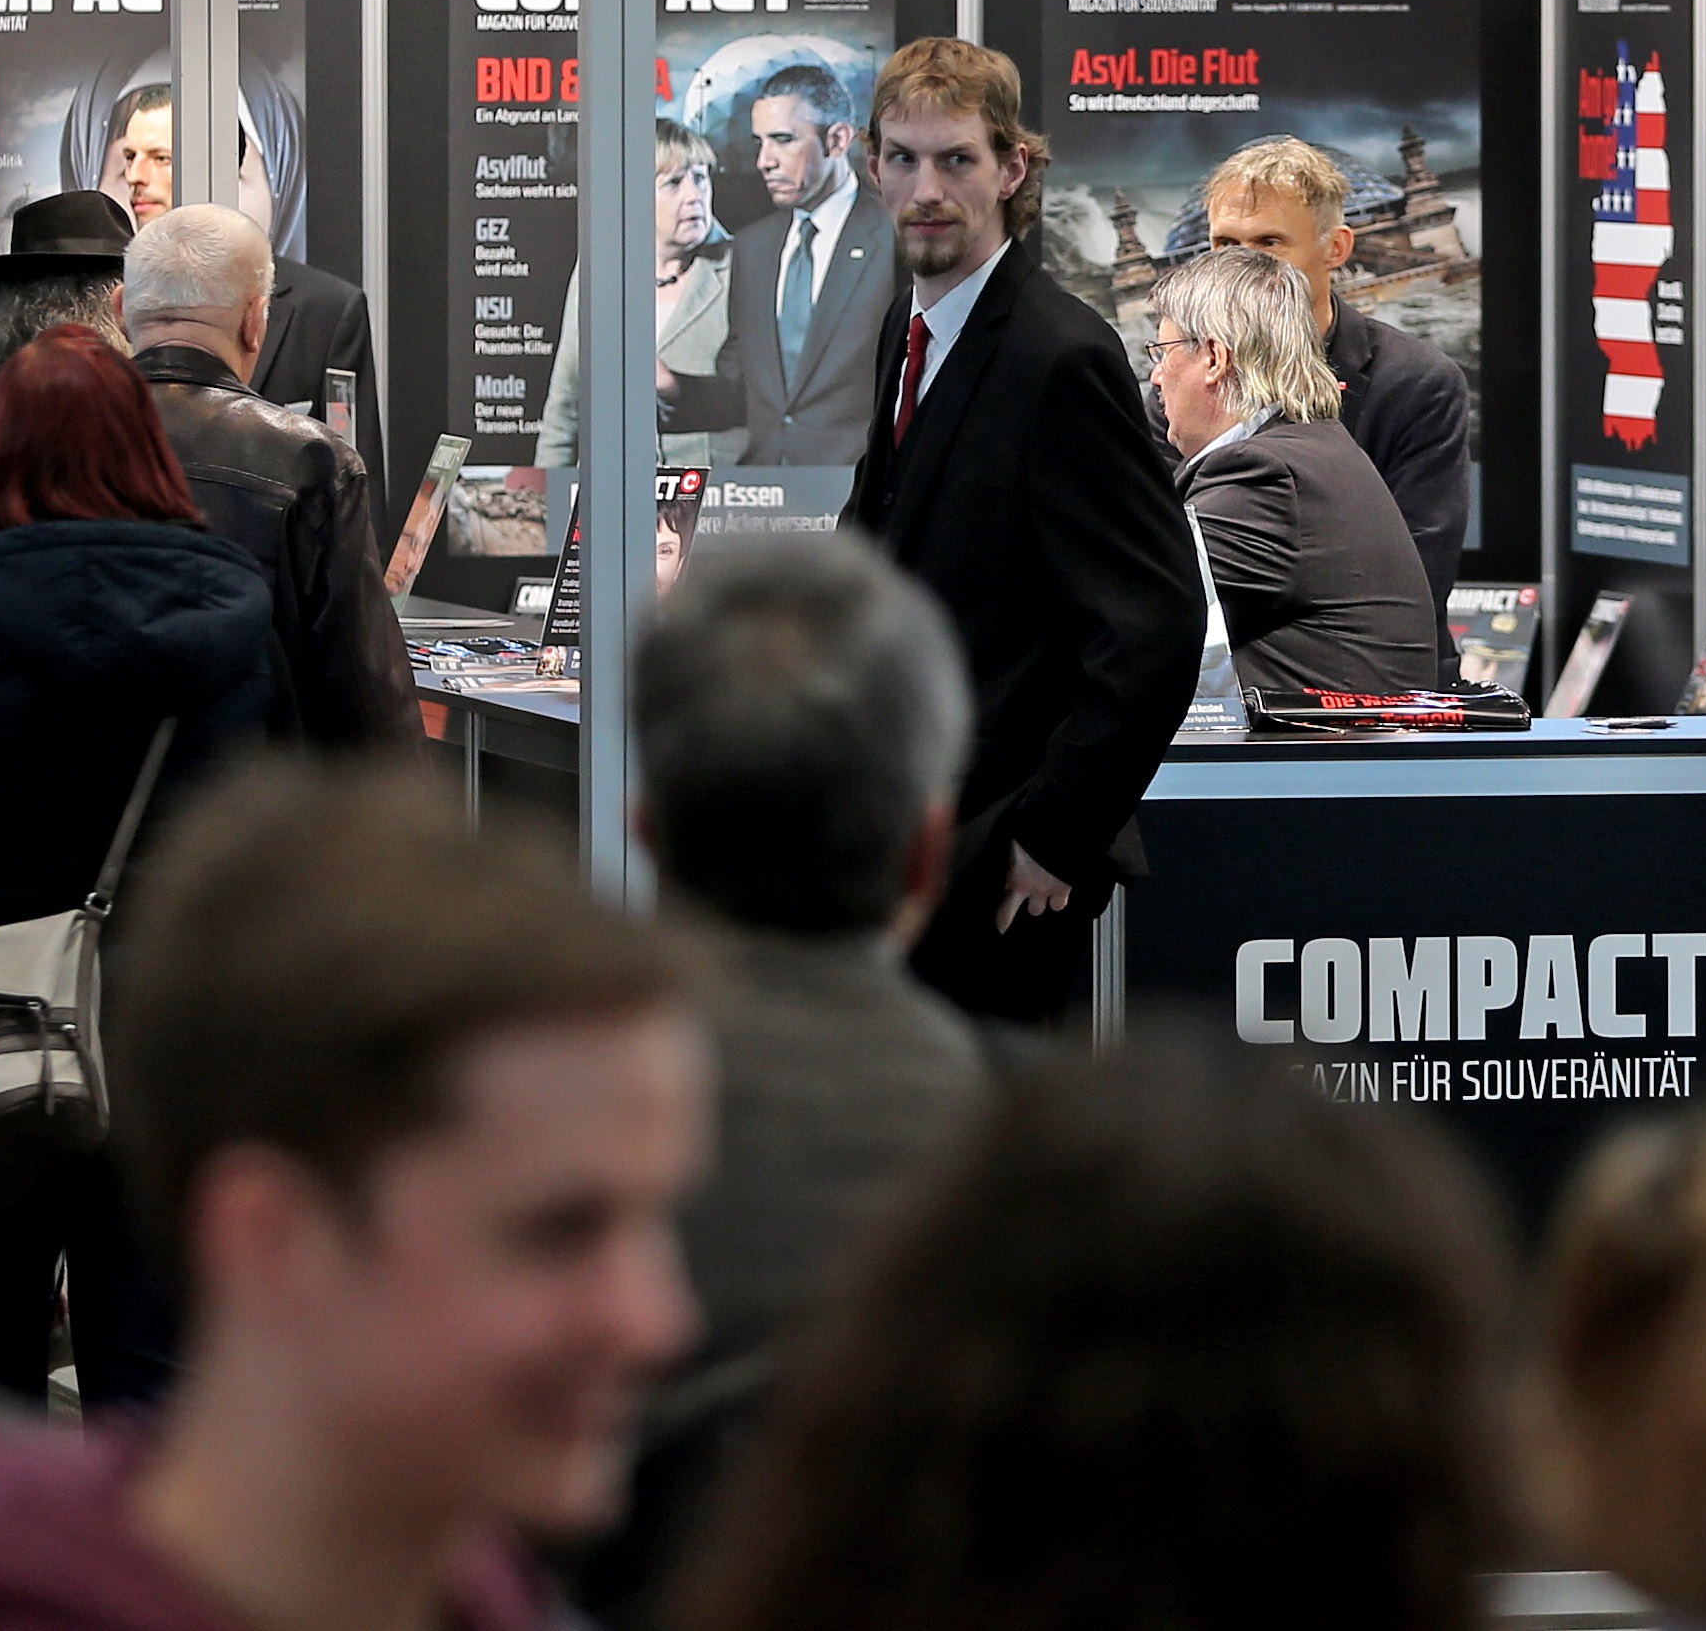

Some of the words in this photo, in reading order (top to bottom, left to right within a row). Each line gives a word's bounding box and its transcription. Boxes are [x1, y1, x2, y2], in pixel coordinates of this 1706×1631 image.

[477, 14, 523, 30] MAGAZIN
[525, 14, 545, 30] FÜR
[477, 57, 552, 102] BND
[1070, 48, 1145, 91] Asyl.
[1150, 48, 1197, 85] Die
[1202, 48, 1260, 85] Flut
[1069, 94, 1086, 111] So
[476, 108, 494, 123] Ein
[495, 108, 541, 126] Abgrund
[542, 111, 556, 123] an
[476, 155, 547, 182] Asylflut
[476, 182, 521, 198] Sachsen
[522, 183, 554, 198] wehrt
[555, 183, 577, 198] sich
[476, 217, 510, 241] GEZ
[475, 296, 513, 320] NSU
[523, 323, 544, 339] Der
[475, 374, 526, 399] Mode
[475, 402, 495, 418] Der
[496, 405, 524, 418] neue
[723, 481, 784, 507] Essen
[697, 516, 720, 533] ere
[1392, 1054, 1451, 1102] FÜR
[1462, 1050, 1697, 1101] SOUVERÄNITÄT
